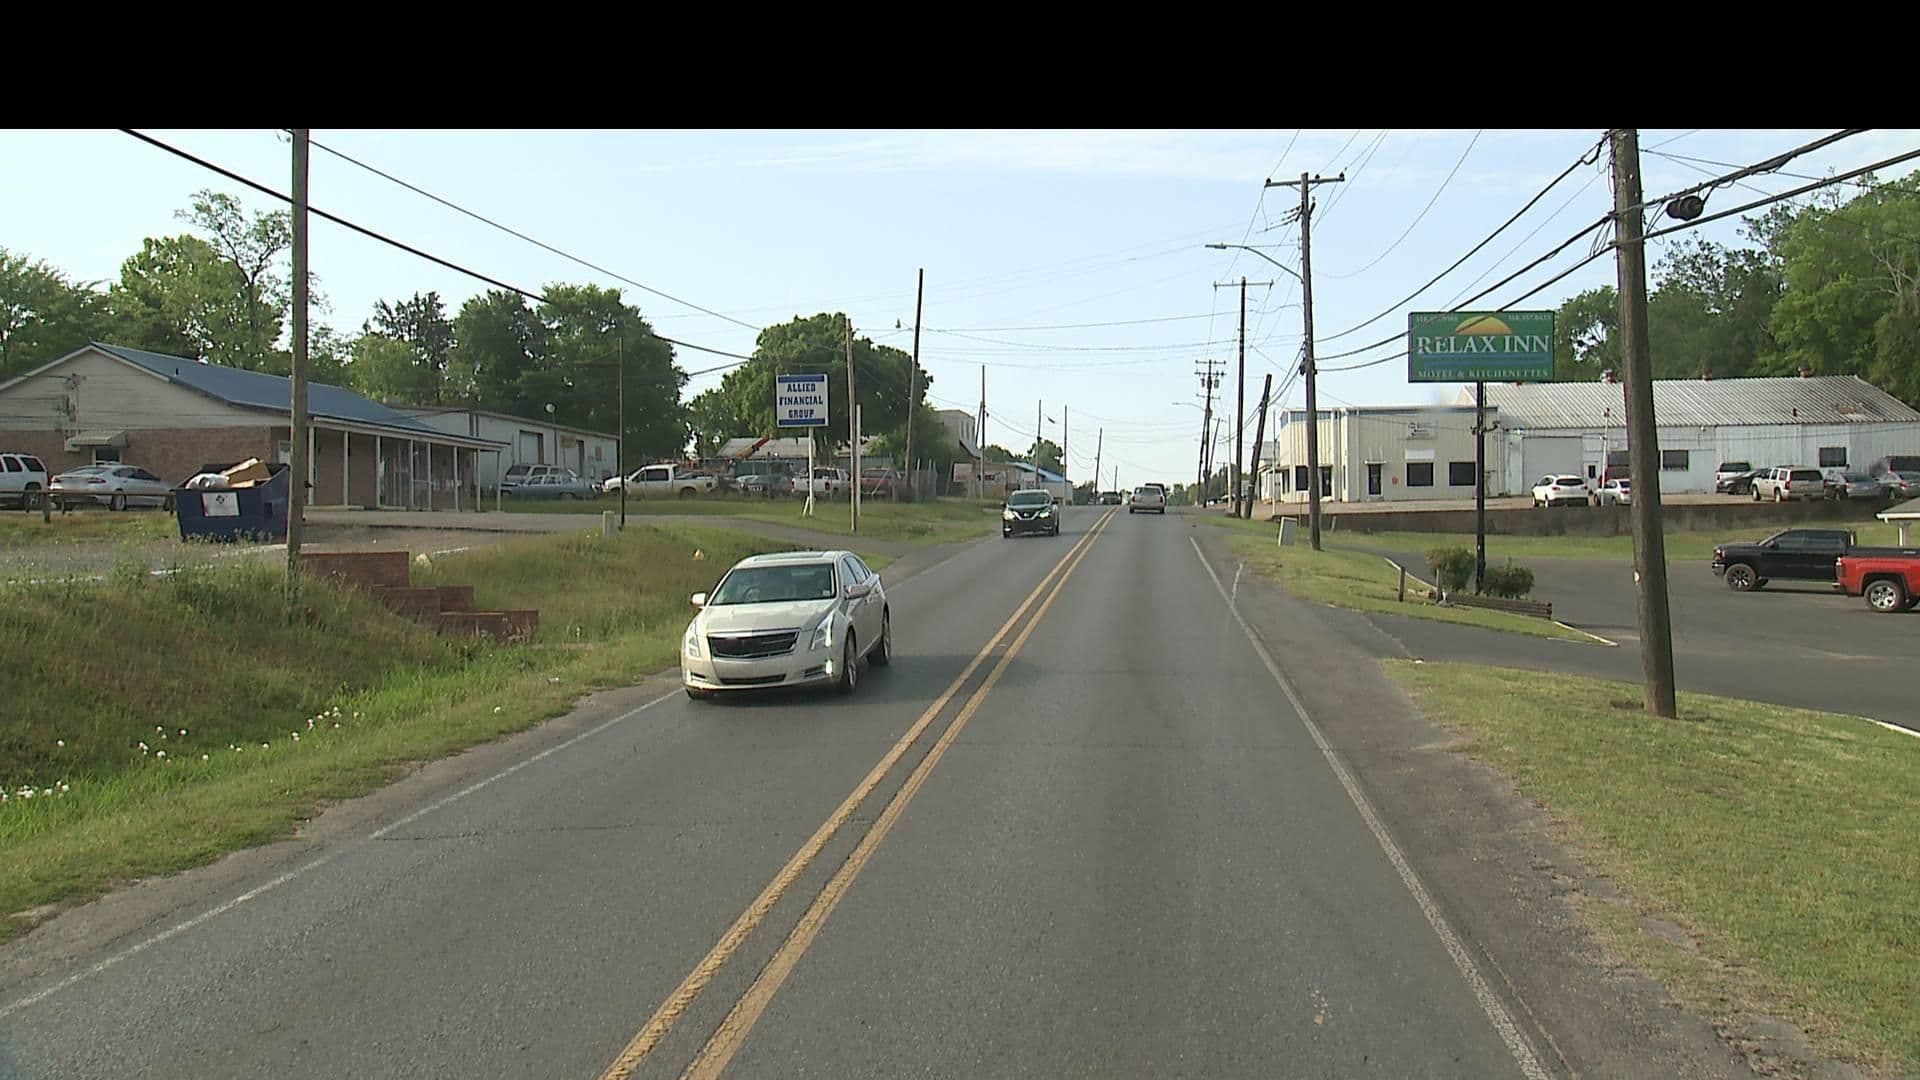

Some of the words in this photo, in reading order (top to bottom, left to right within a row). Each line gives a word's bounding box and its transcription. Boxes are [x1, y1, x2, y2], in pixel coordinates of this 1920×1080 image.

[1416, 335, 1497, 354] RELAX
[1504, 335, 1549, 353] INN
[1418, 369, 1452, 378] MOTEL
[1469, 369, 1548, 378] KITCHENETTES
[787, 383, 816, 393] ALLIED
[779, 396, 823, 406] FINANCIAL
[788, 409, 815, 418] GROUP
